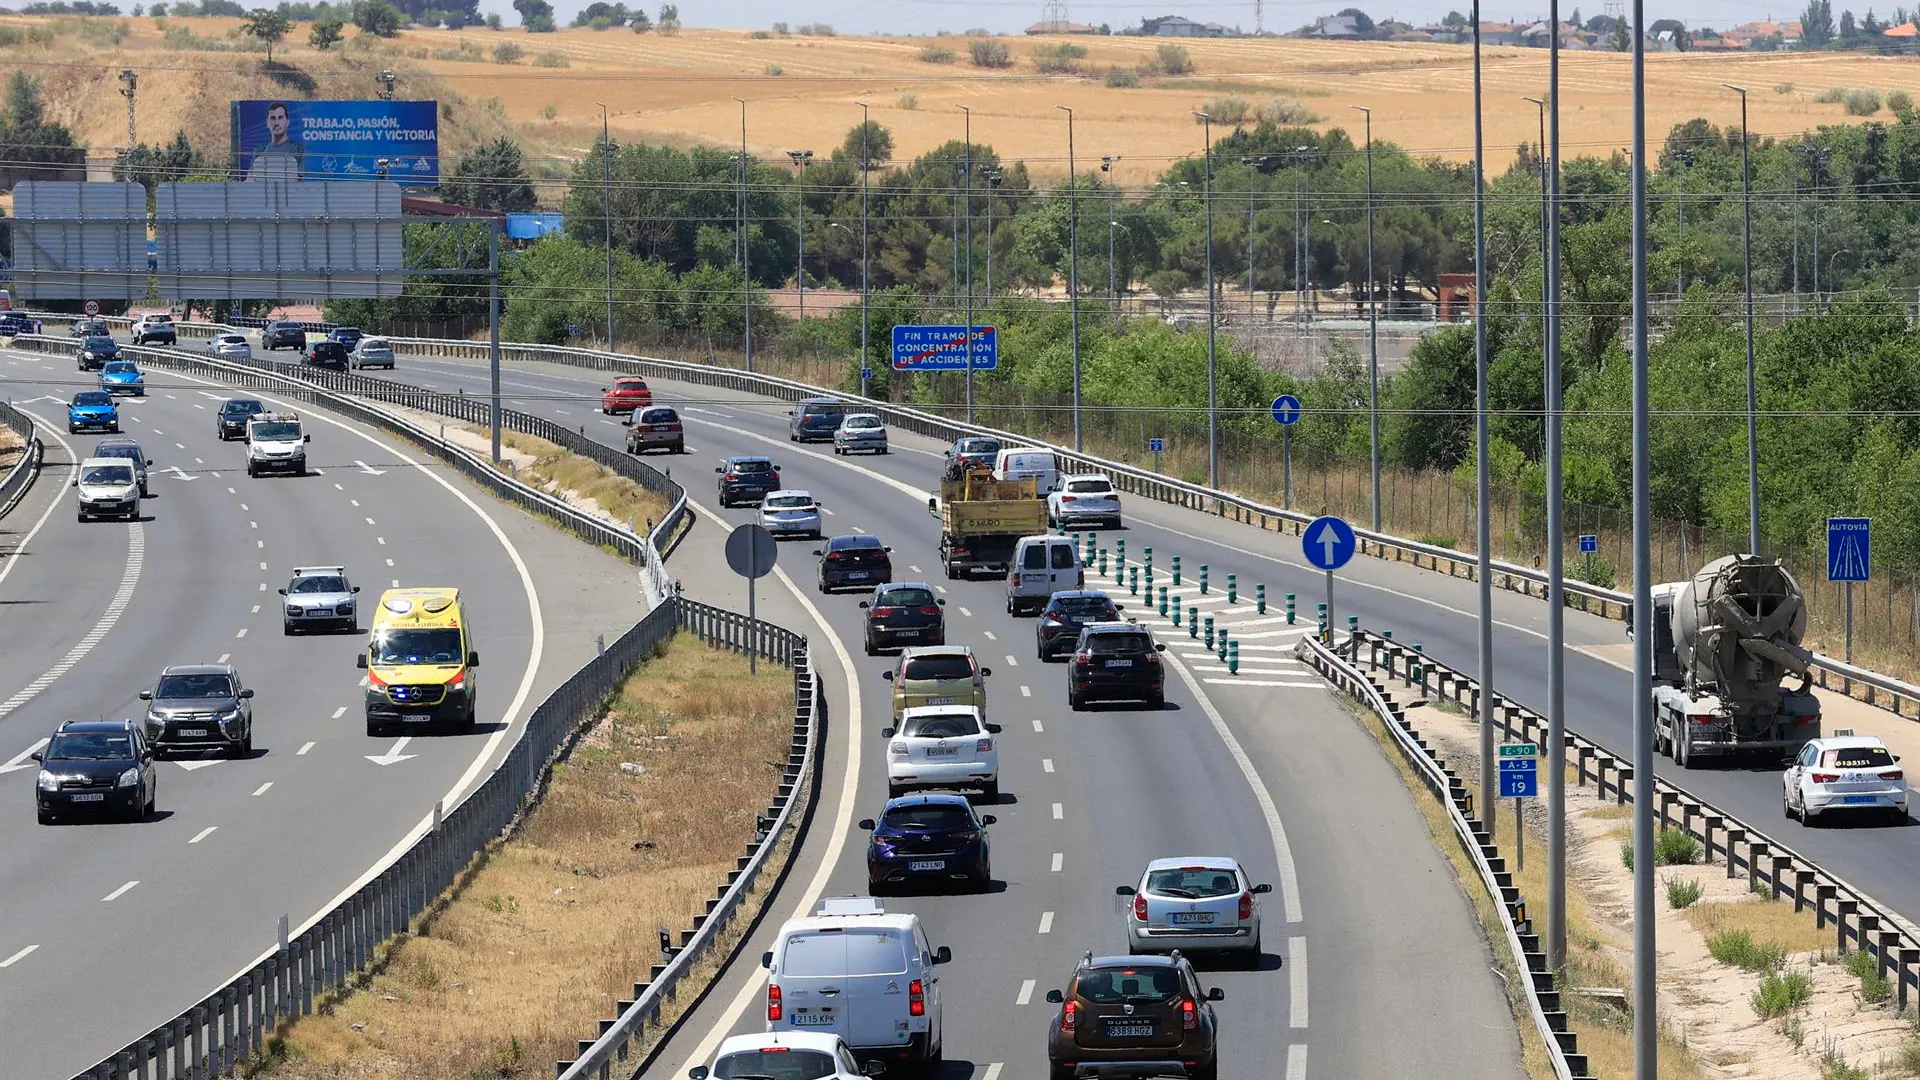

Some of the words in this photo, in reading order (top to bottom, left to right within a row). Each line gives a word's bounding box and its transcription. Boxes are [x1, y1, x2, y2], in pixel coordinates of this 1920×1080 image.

[302, 117, 356, 130] TRABAJO,
[357, 115, 400, 129] PASIÓN,
[302, 130, 374, 141] CONSTANCIA
[376, 130, 382, 140] Y
[385, 129, 436, 141] VICTORIA
[904, 332, 921, 340] FIN
[927, 331, 966, 340] TRAMO
[971, 332, 985, 340] DE
[900, 356, 914, 364] DE
[920, 355, 989, 364] ACCIDENES
[976, 519, 1000, 527] MURO
[1830, 521, 1868, 531] AUTOVÍA
[1505, 746, 1530, 755] E-90
[1508, 760, 1529, 769] A-5
[1511, 781, 1526, 793] 19
[797, 1015, 818, 1024] 2115
[819, 1014, 835, 1023] KPK
[1110, 1026, 1132, 1035] 6389
[1134, 1025, 1151, 1035] HGZ
